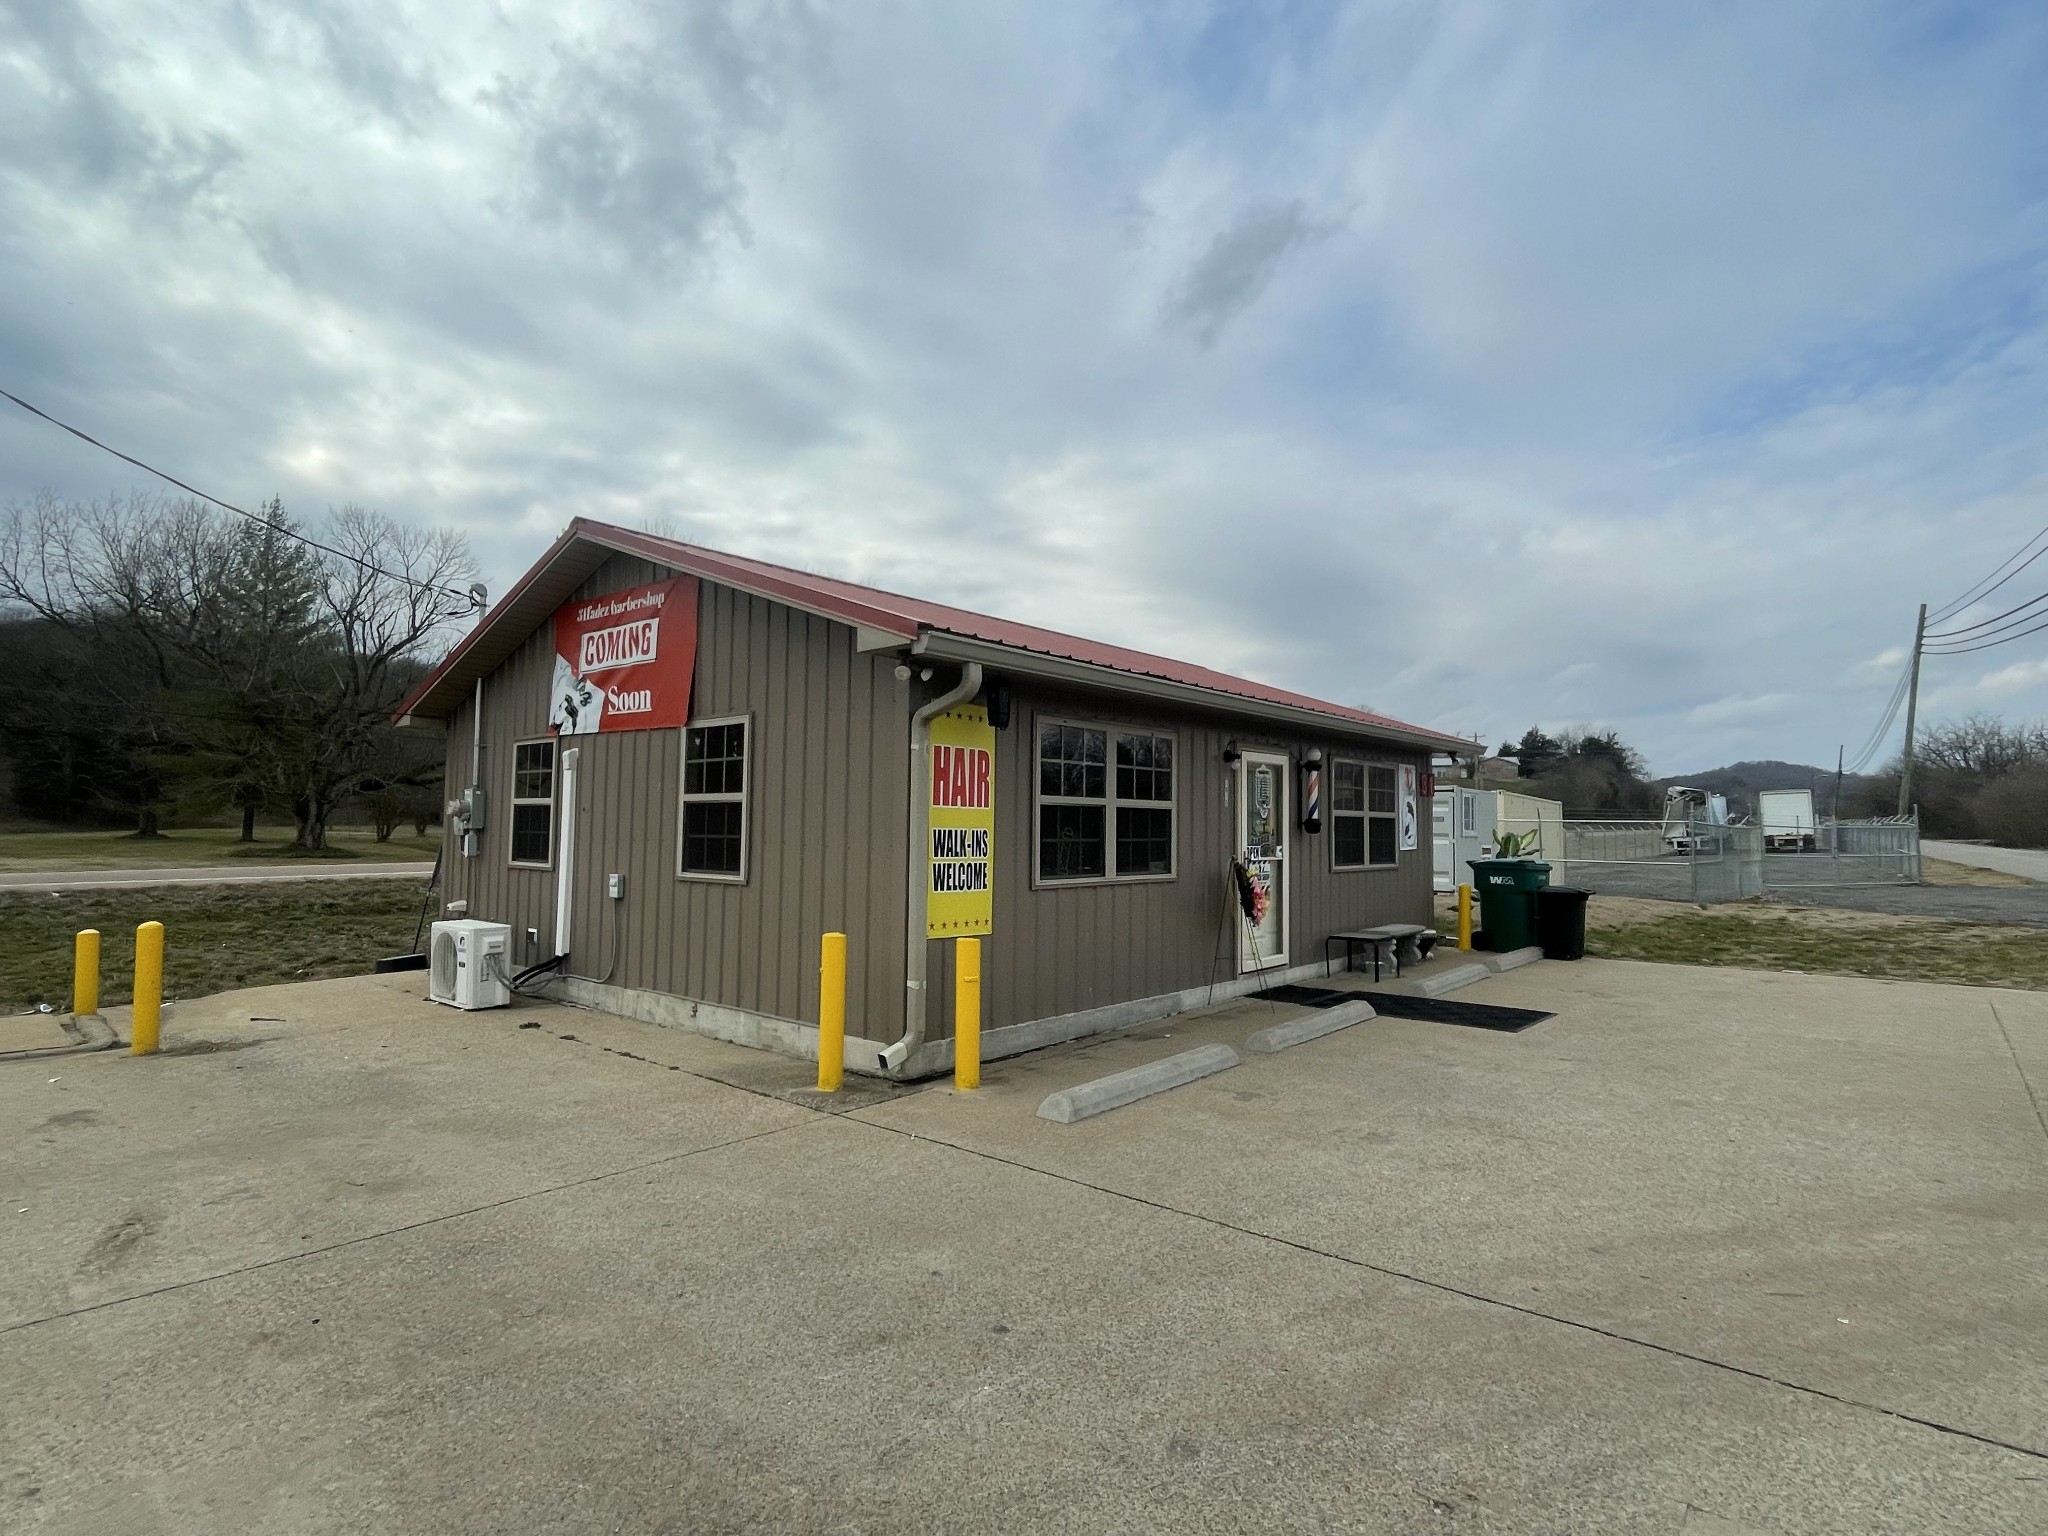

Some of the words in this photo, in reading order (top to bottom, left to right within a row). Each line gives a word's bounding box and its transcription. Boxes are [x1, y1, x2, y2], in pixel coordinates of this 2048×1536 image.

[610, 591, 665, 615] barbershop
[584, 622, 653, 667] COMING
[608, 686, 652, 713] Soon
[932, 744, 990, 808] HAIR
[933, 828, 988, 858] WALK-INS
[933, 861, 988, 892] WELCOME
